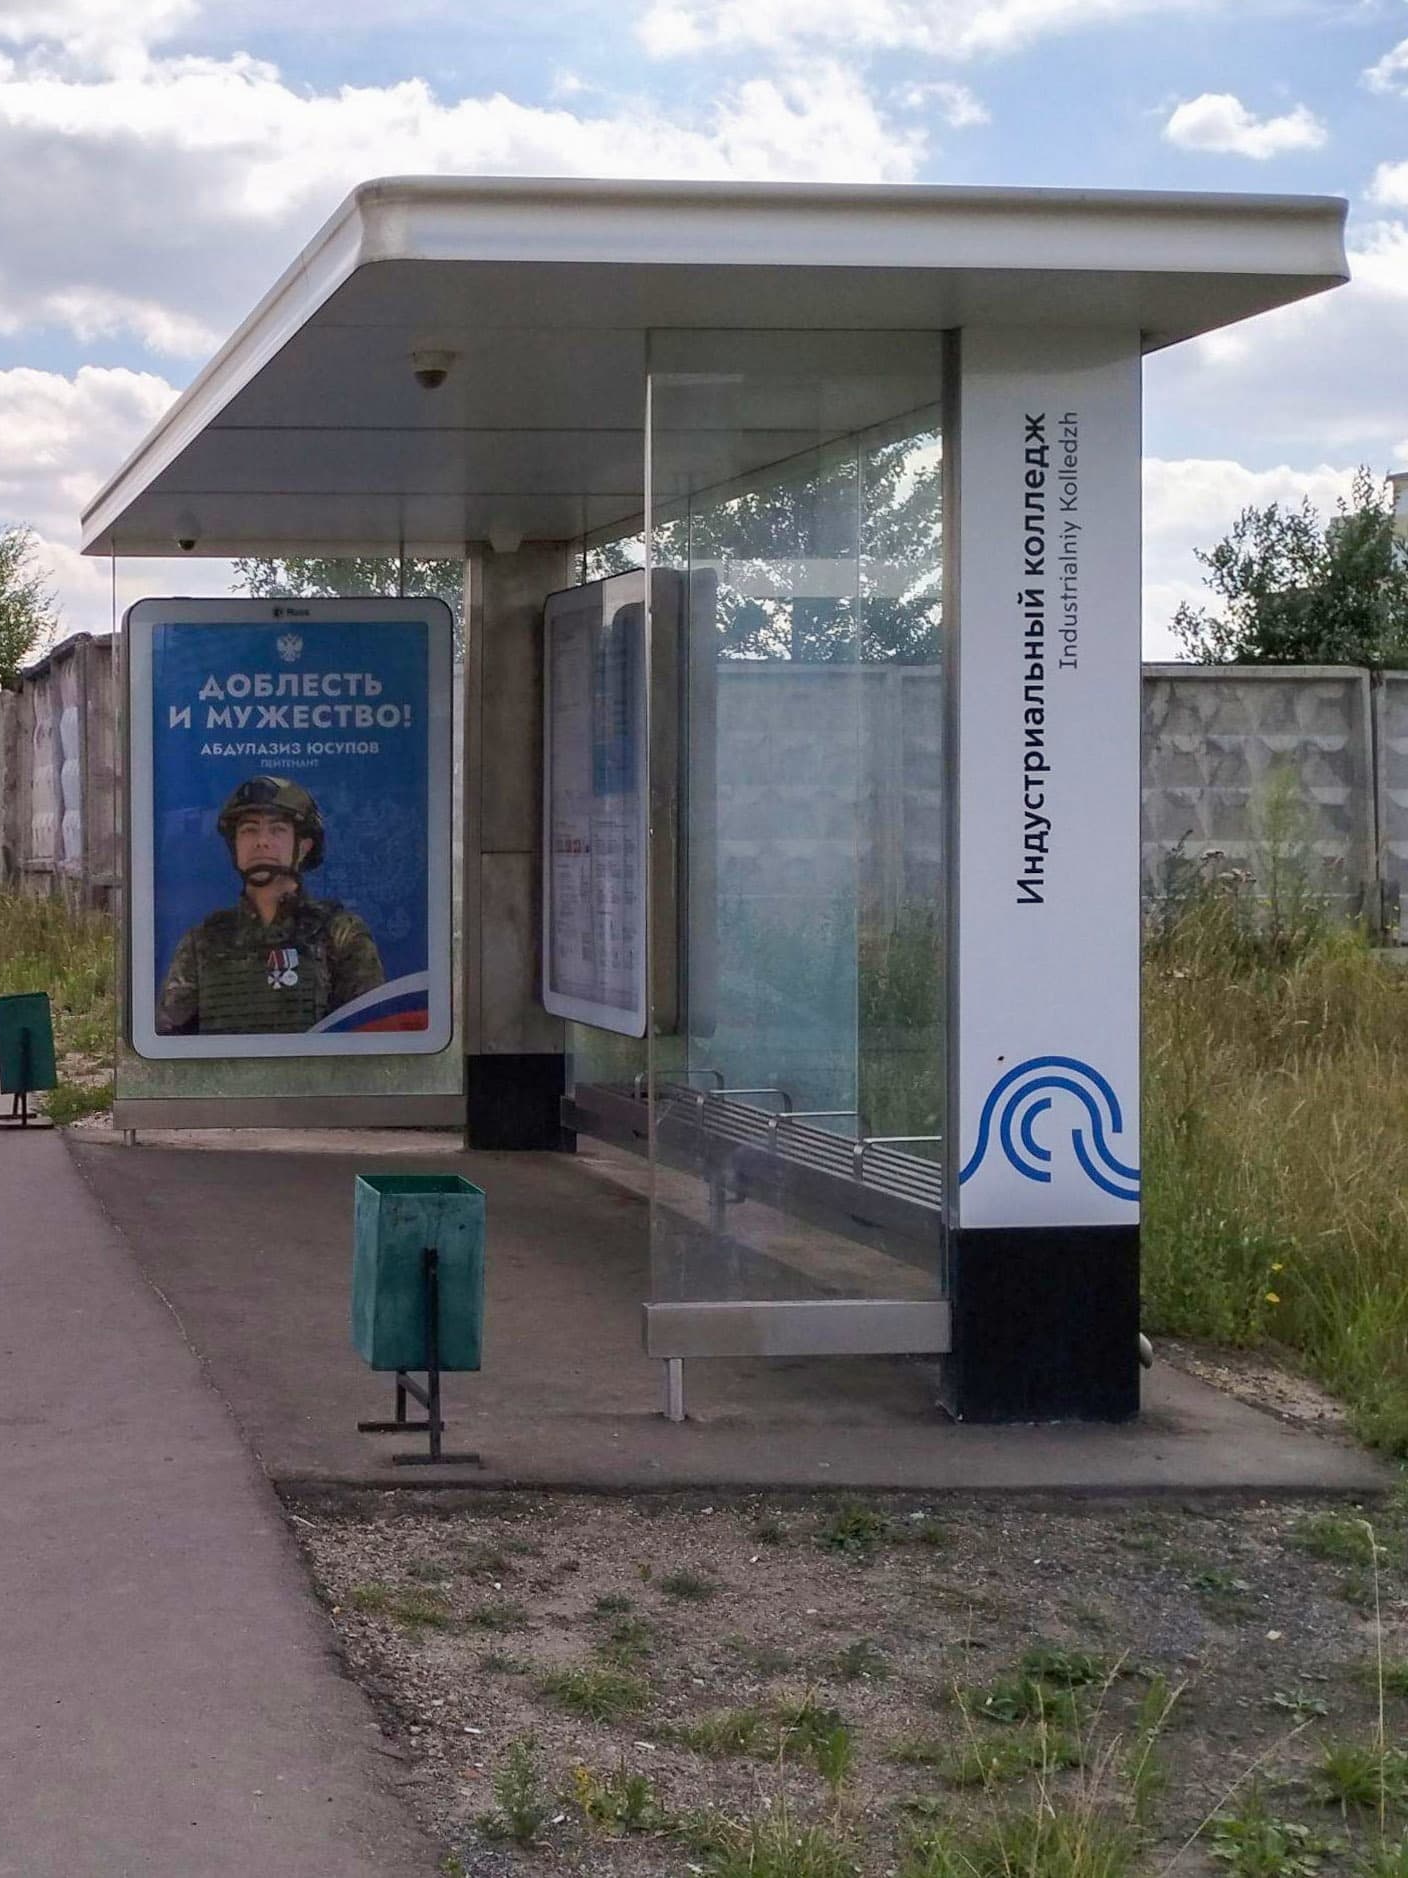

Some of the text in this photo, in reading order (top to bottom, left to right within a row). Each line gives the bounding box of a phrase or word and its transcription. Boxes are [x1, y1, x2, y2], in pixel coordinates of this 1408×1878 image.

[1058, 411, 1083, 670] Industrialniy Kolledzh
[1017, 412, 1052, 904] Индустриальный колледж
[198, 673, 382, 700] ДОБЛЕСТЬ
[169, 704, 412, 729] И МУЖЕСТВО!
[200, 742, 379, 757] АБДУЛАЗИЗ ЮСУПОВ
